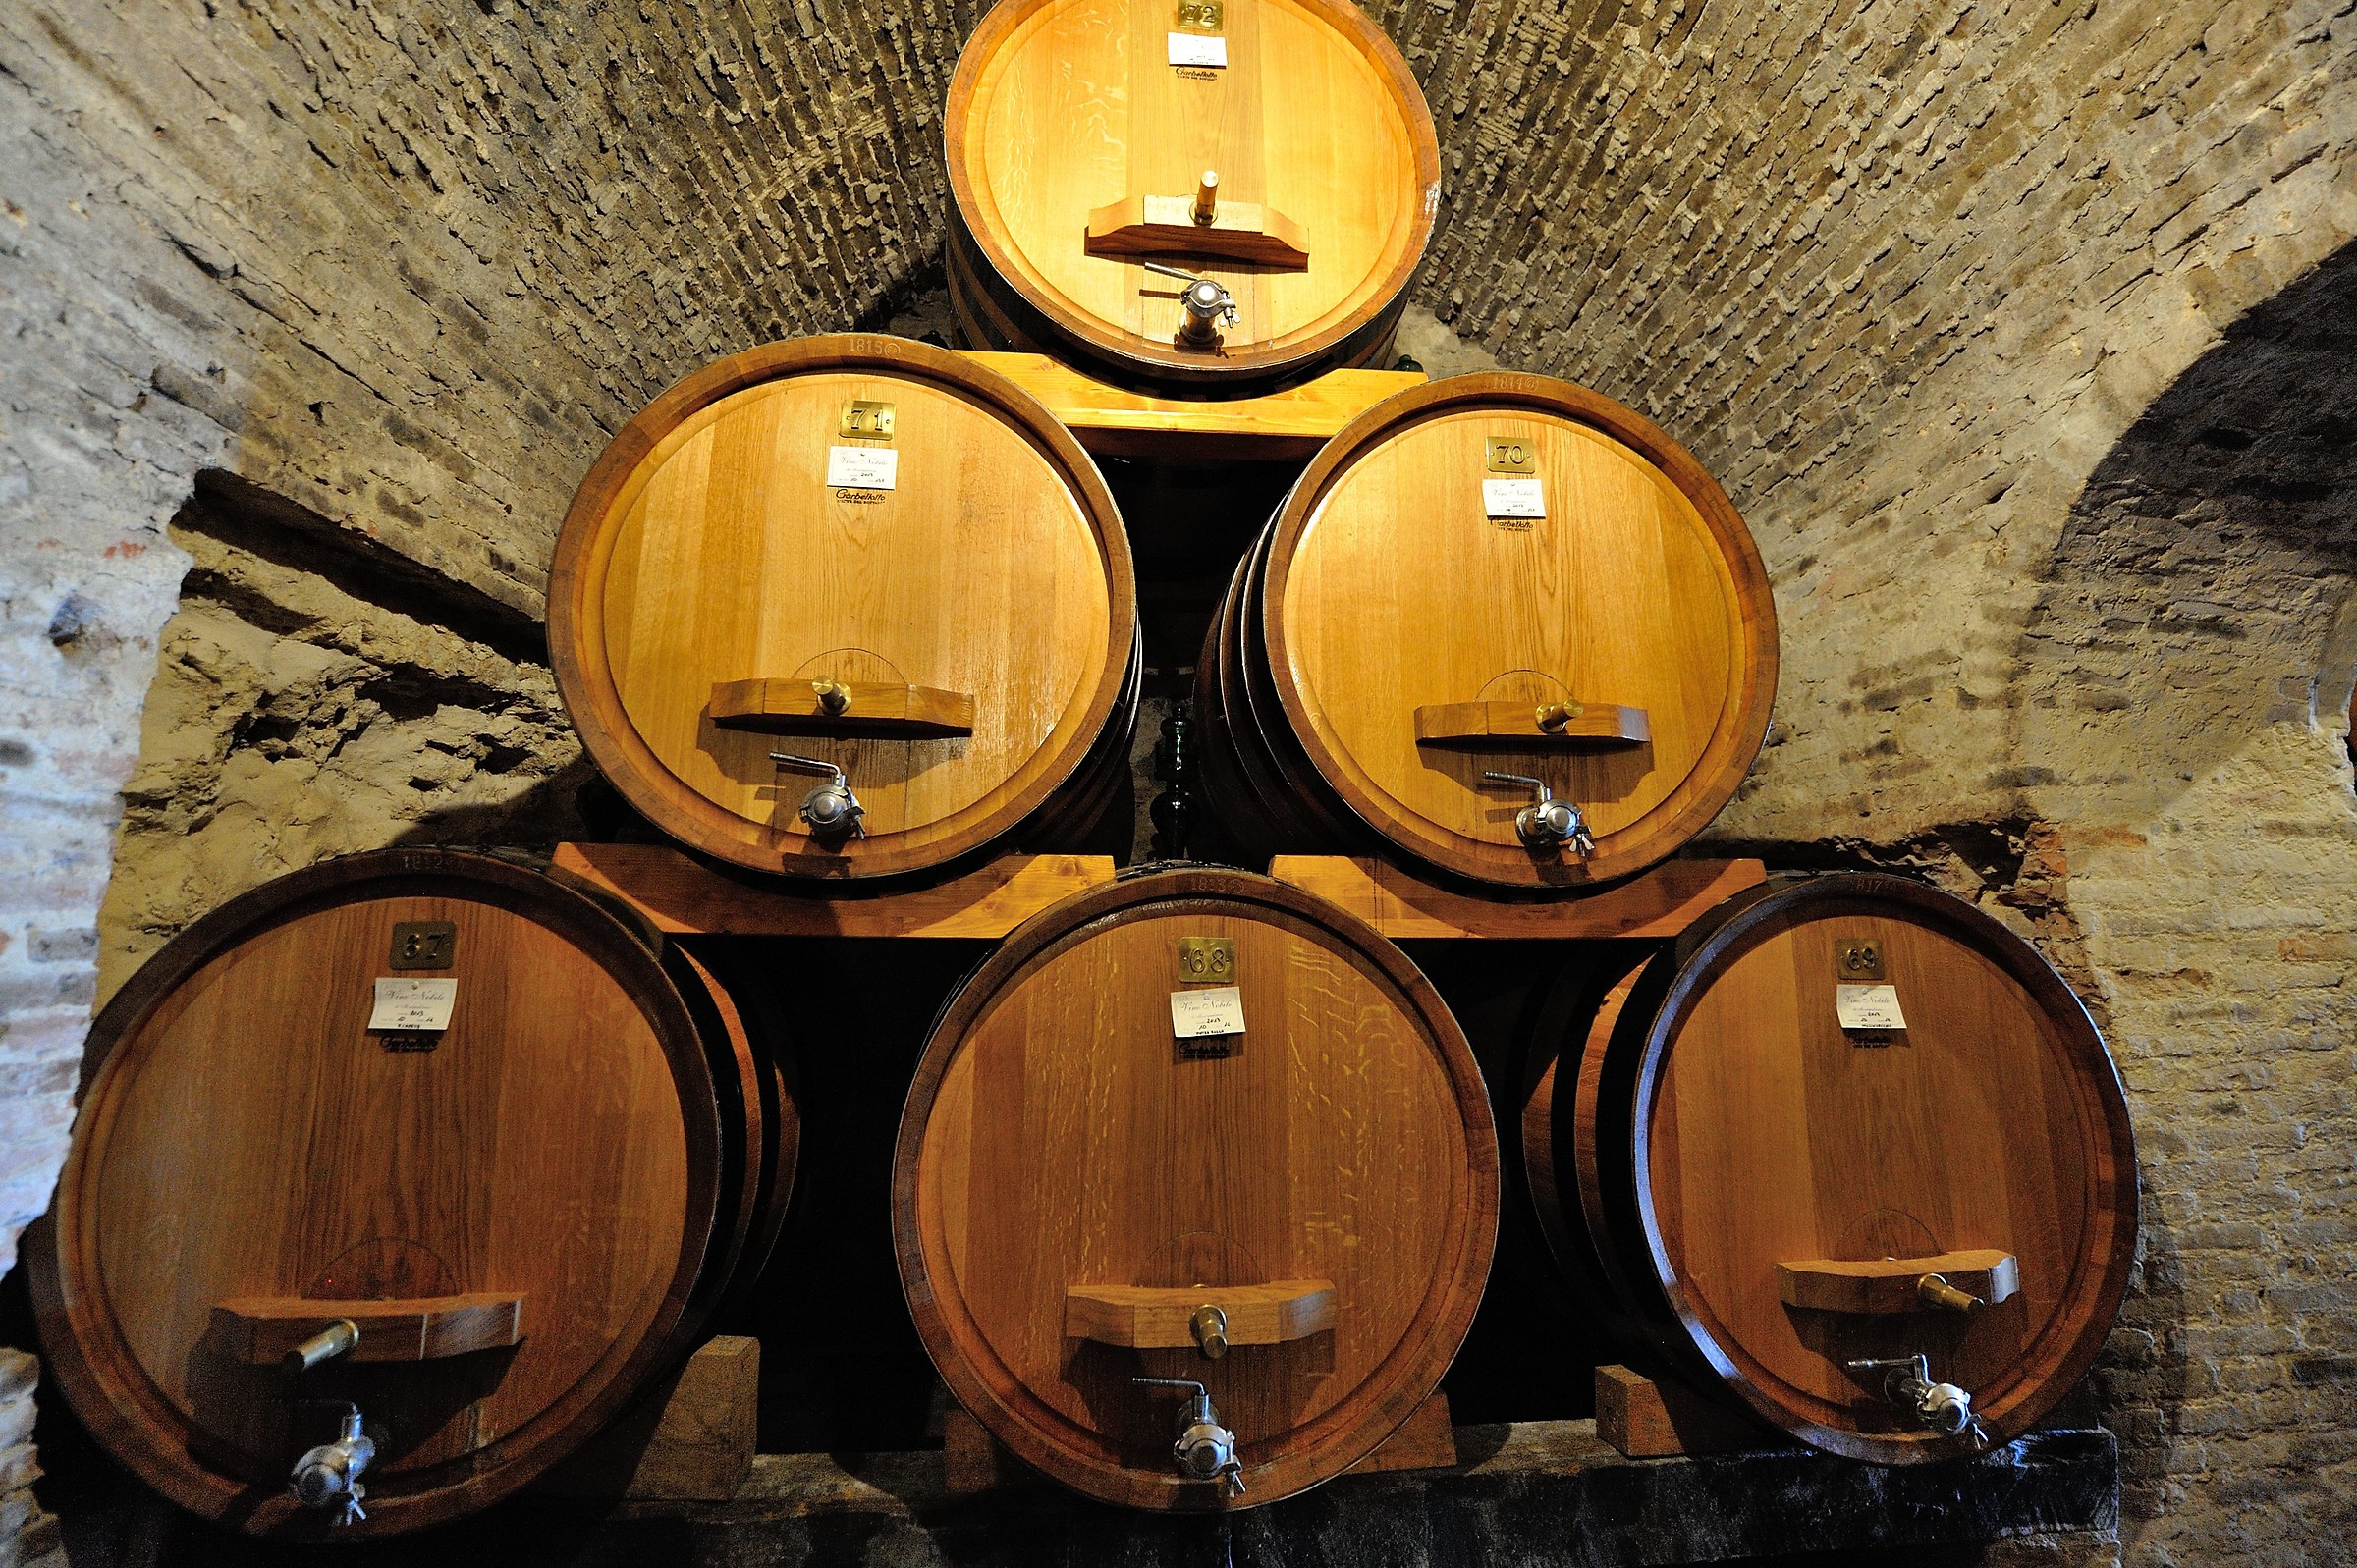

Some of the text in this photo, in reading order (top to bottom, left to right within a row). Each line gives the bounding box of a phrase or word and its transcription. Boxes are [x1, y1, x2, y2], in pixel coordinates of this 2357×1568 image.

[1186, 4, 1216, 24] 72
[849, 338, 883, 354] 1815
[850, 408, 884, 431] 71
[1496, 445, 1526, 464] 70
[1189, 948, 1225, 973] 68
[1846, 947, 1875, 970] 69
